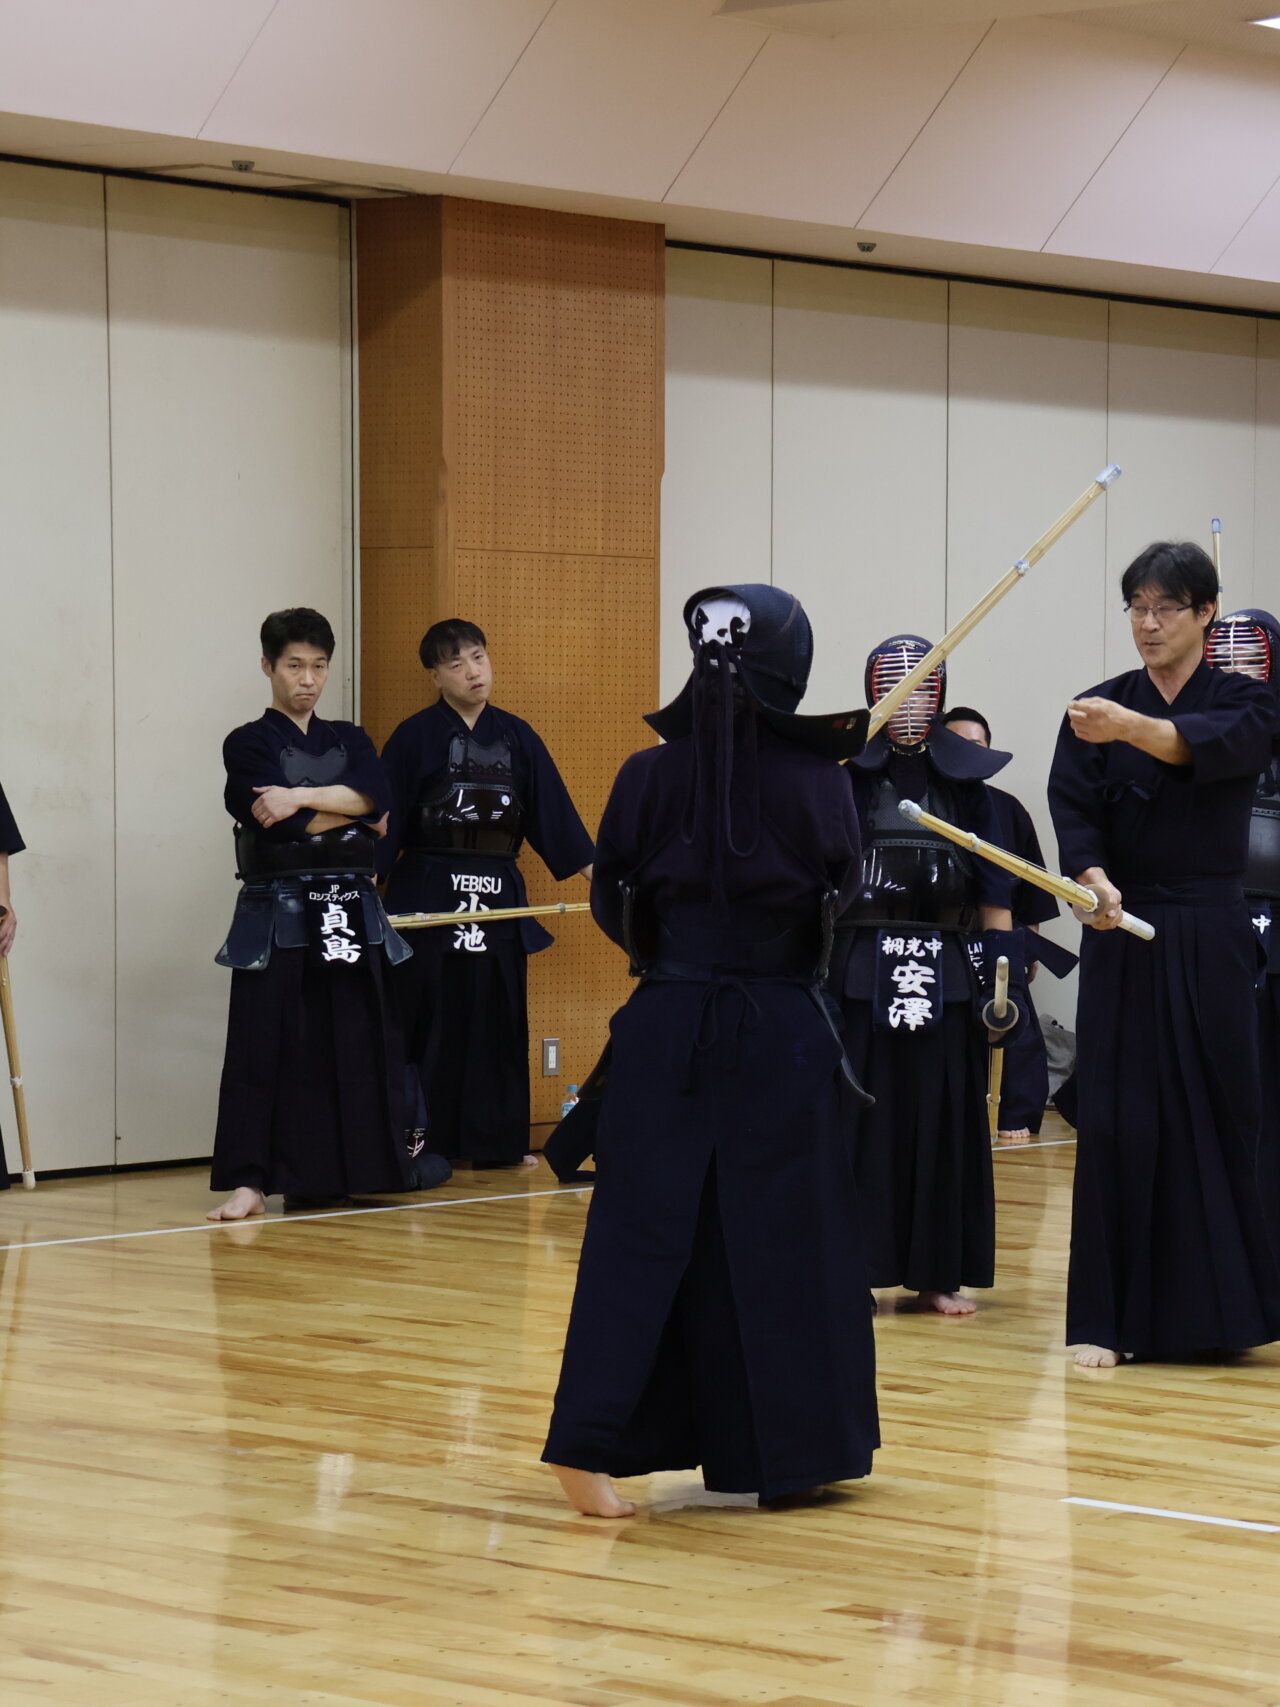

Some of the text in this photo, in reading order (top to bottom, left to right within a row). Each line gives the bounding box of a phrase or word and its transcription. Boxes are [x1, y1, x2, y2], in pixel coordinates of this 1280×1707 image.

[329, 884, 340, 894] JP
[451, 873, 502, 894] YEBISU
[320, 902, 362, 964] 貞島
[888, 960, 936, 1031] 安澤
